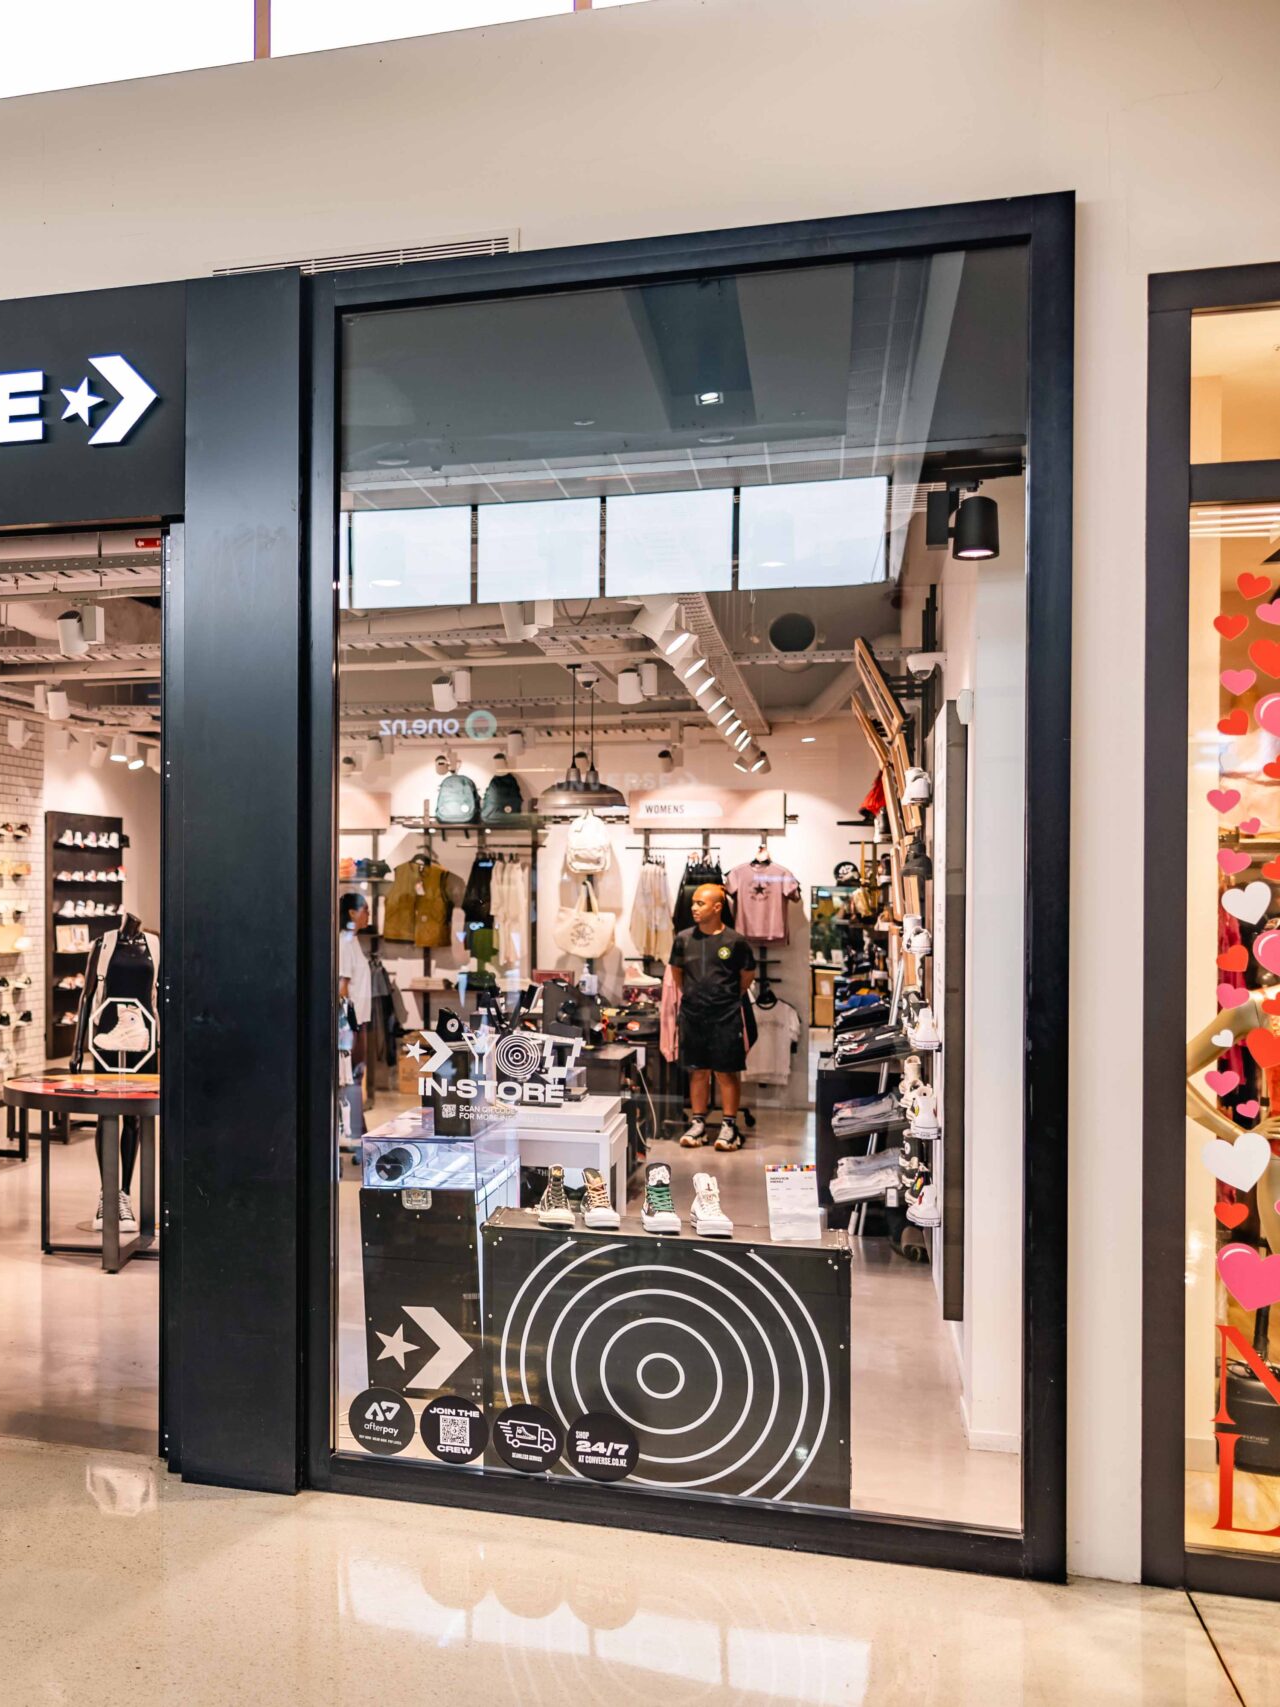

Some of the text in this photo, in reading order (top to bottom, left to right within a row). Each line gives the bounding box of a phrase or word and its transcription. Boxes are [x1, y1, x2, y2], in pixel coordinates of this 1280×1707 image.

[645, 804, 685, 814] WOMENS
[418, 1076, 565, 1103] IN-STORE
[459, 1104, 480, 1113] SCAN
[459, 1112, 475, 1121] FOR
[429, 1407, 480, 1418] JOIN THE
[363, 1421, 399, 1437] afterpay
[575, 1430, 590, 1440] SHOP
[437, 1444, 473, 1455] CREW
[576, 1440, 629, 1456] 24/7
[584, 1455, 628, 1468] CONVERSE.CO.NZ
